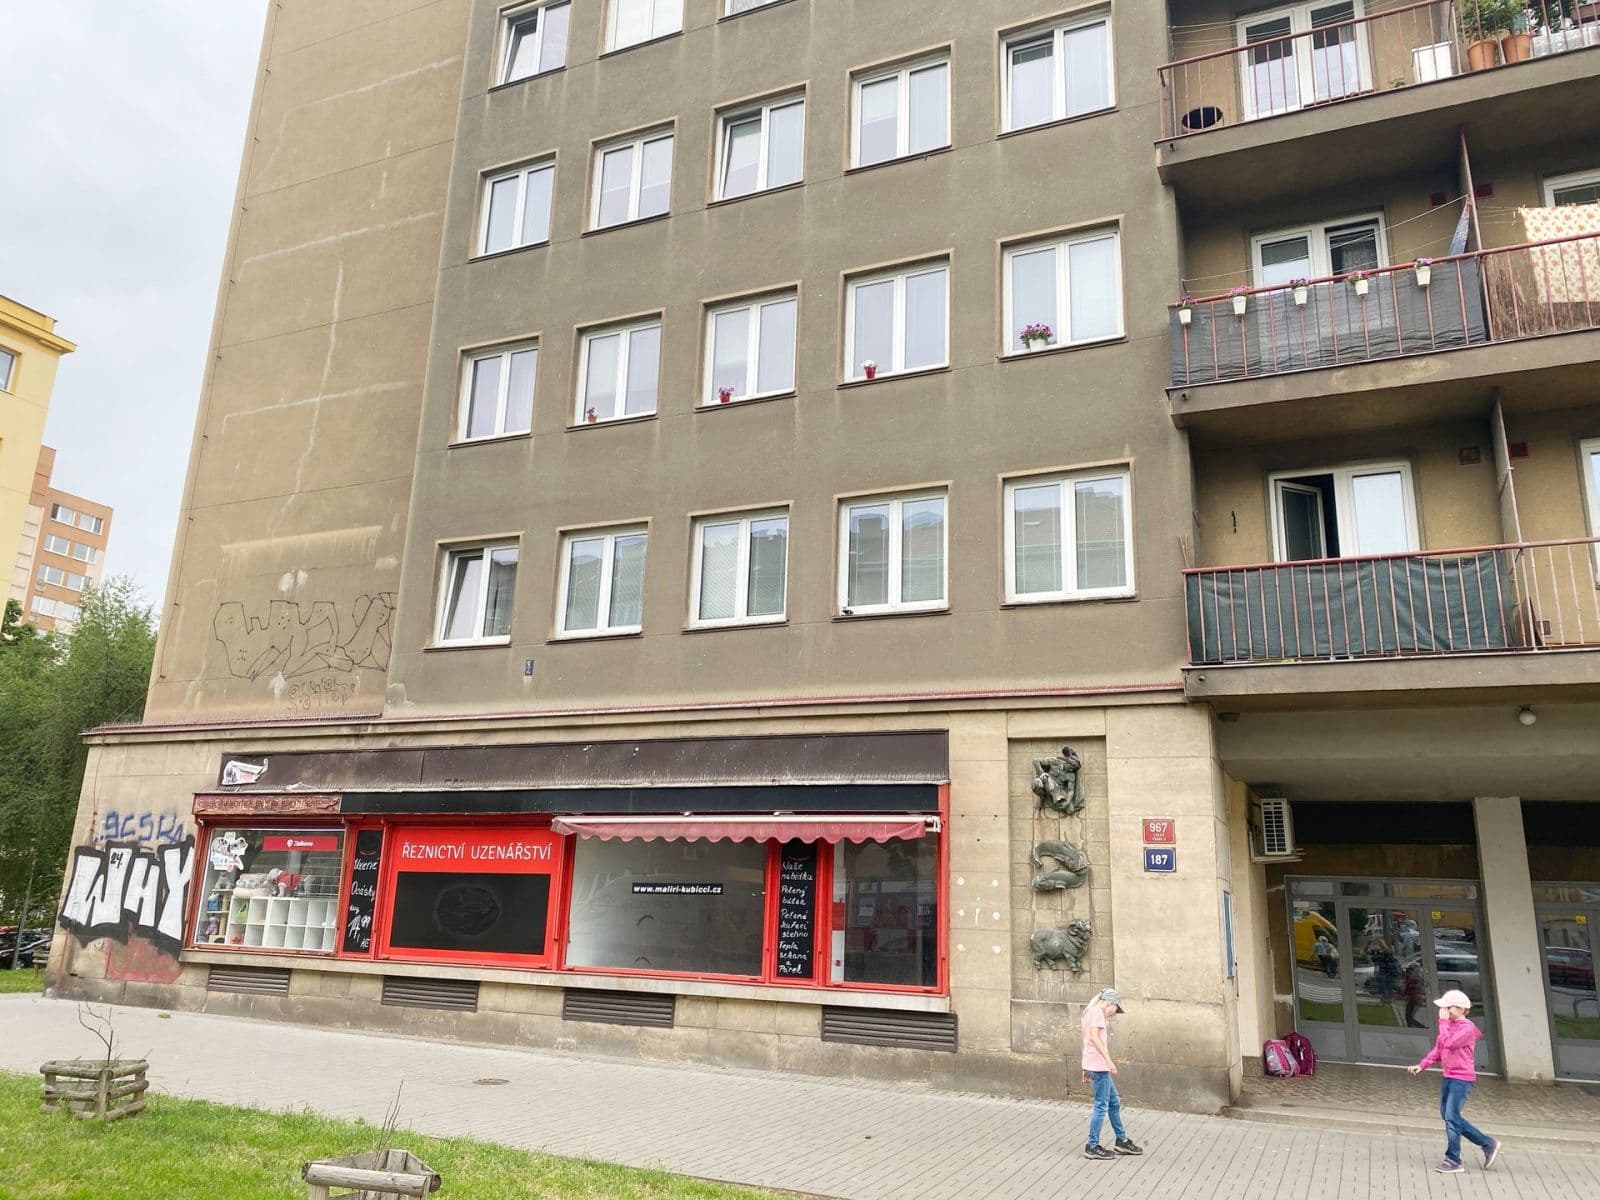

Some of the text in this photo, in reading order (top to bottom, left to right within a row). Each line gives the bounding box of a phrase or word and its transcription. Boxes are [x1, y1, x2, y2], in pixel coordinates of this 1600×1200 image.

[1149, 822, 1168, 832] 967
[402, 842, 552, 860] ŘEZNICTVÍ UZENÁŘSTVÍ
[1151, 854, 1168, 864] 187
[781, 930, 809, 938] stehno
